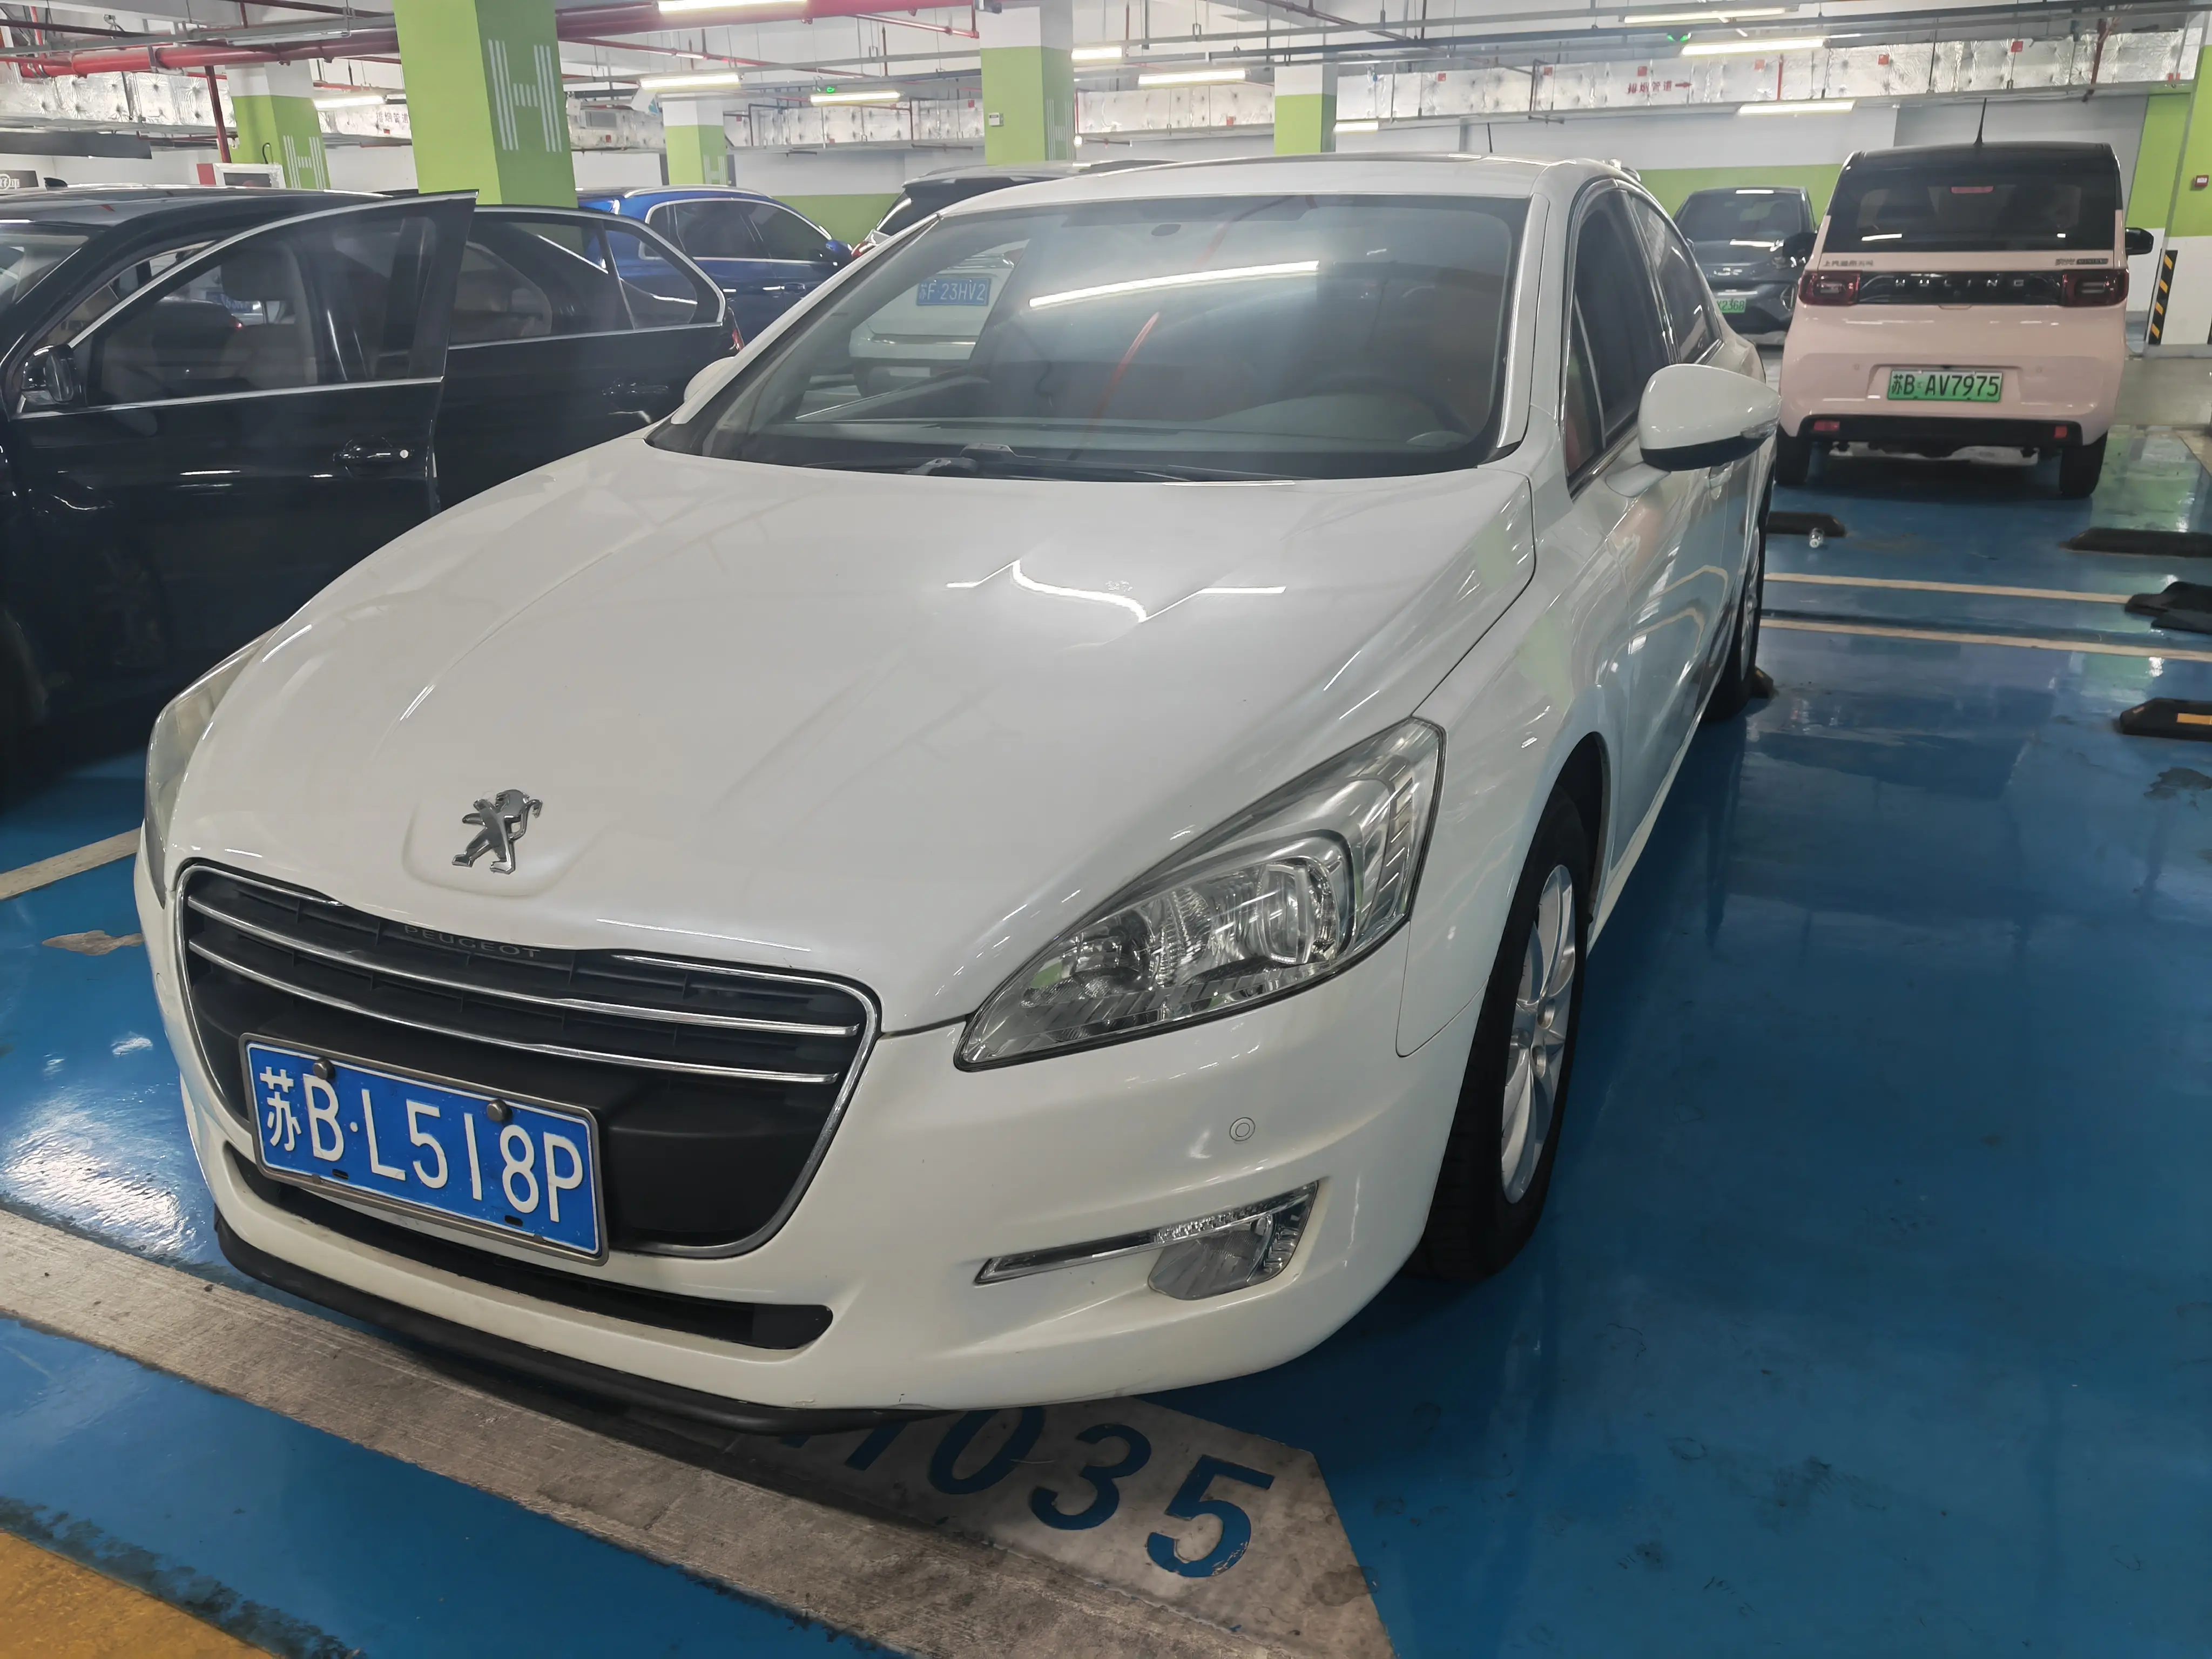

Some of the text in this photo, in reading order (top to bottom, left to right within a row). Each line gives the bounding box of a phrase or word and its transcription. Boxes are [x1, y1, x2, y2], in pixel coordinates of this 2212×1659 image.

[488, 38, 562, 153] H
[283, 135, 327, 190] H
[404, 925, 541, 957] PEUGEOT
